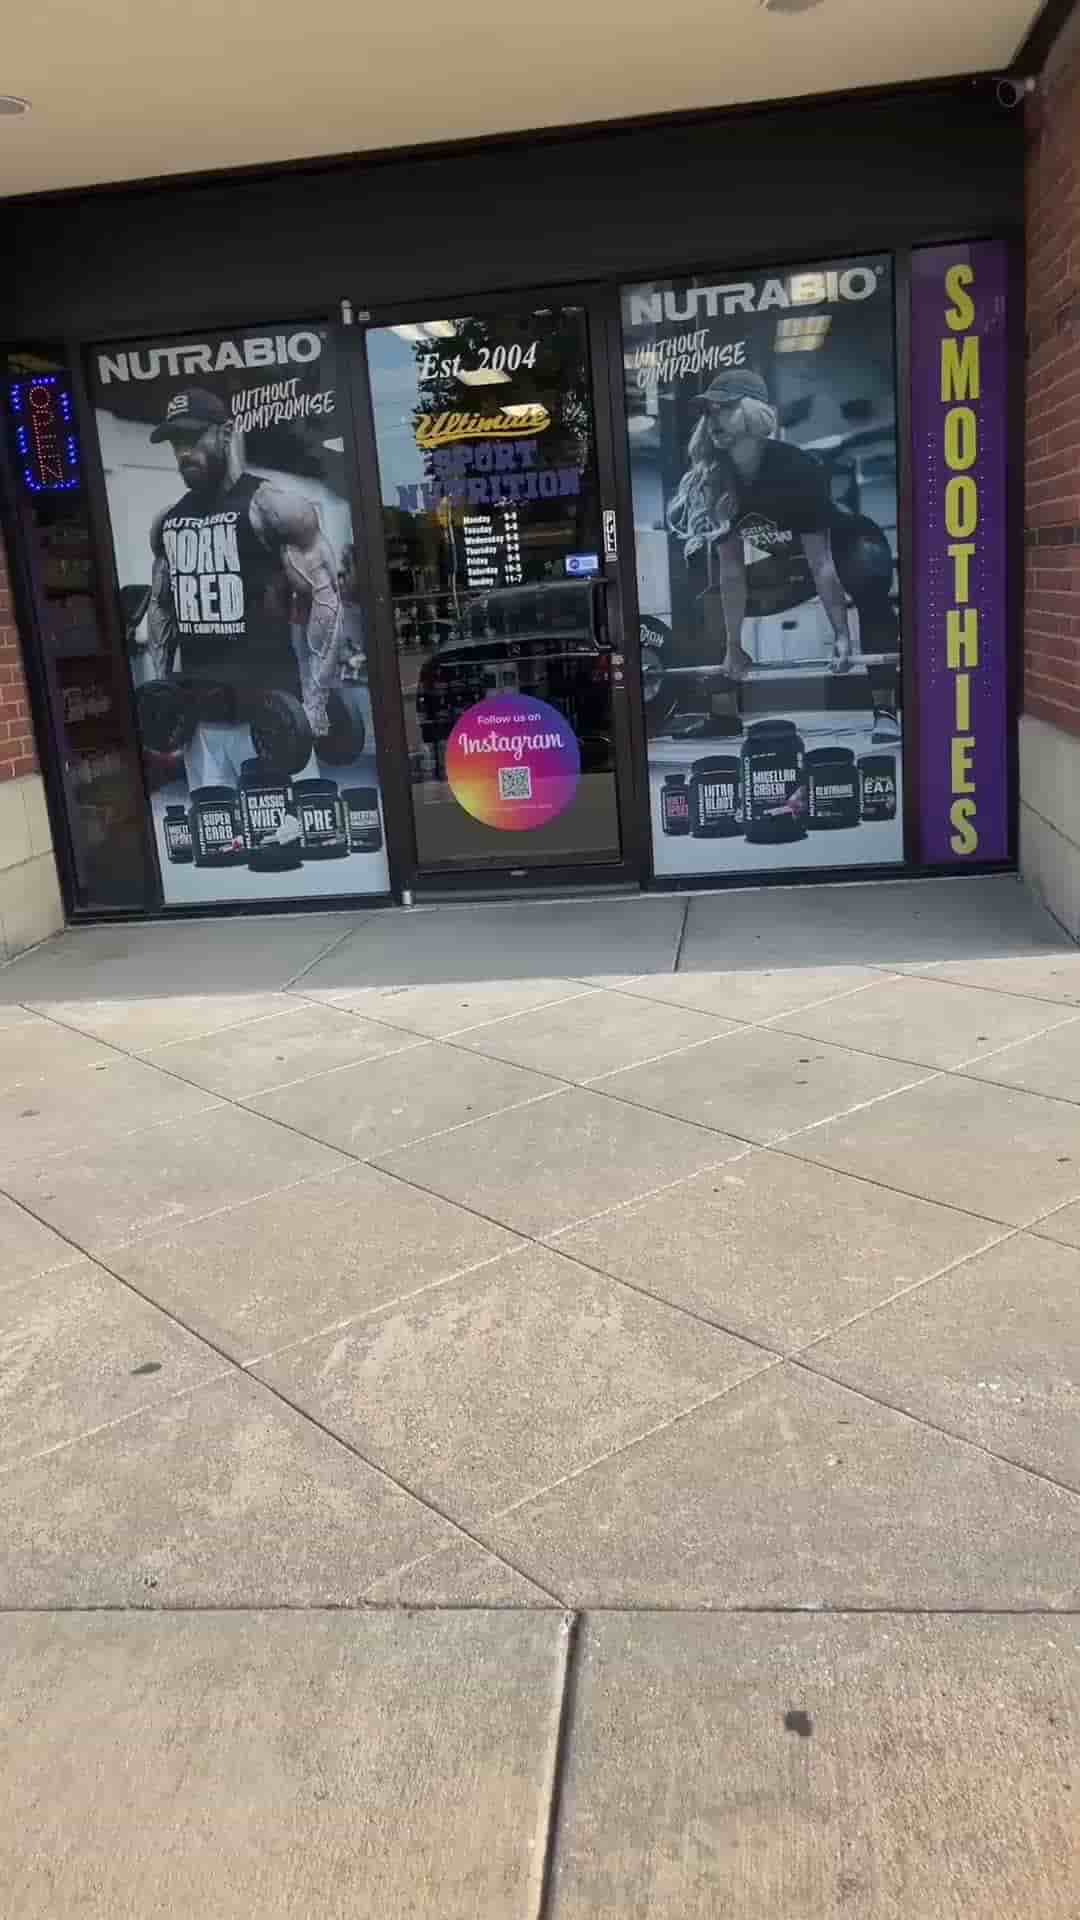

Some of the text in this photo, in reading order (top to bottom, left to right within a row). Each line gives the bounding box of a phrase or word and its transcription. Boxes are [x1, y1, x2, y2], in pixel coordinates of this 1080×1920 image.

[630, 267, 877, 325] NUTRABIO
[97, 331, 322, 384] NUTRABIO
[477, 342, 537, 371] 2004
[634, 329, 710, 368] WITHOUT
[637, 341, 746, 388] COMPROMISE
[231, 377, 301, 415] WITHOUT
[232, 391, 336, 433] COMPROMISE
[416, 408, 551, 448] Ultimate
[431, 440, 536, 476] SPORT
[940, 264, 981, 855] SMOOTHIES
[477, 713, 542, 724] Follow us on
[458, 731, 564, 760] Instagram
[864, 782, 894, 793] EAA
[203, 813, 231, 826] SUPER
[204, 825, 233, 841] CARB
[249, 807, 287, 829] WHEY
[303, 808, 333, 832] PRE
